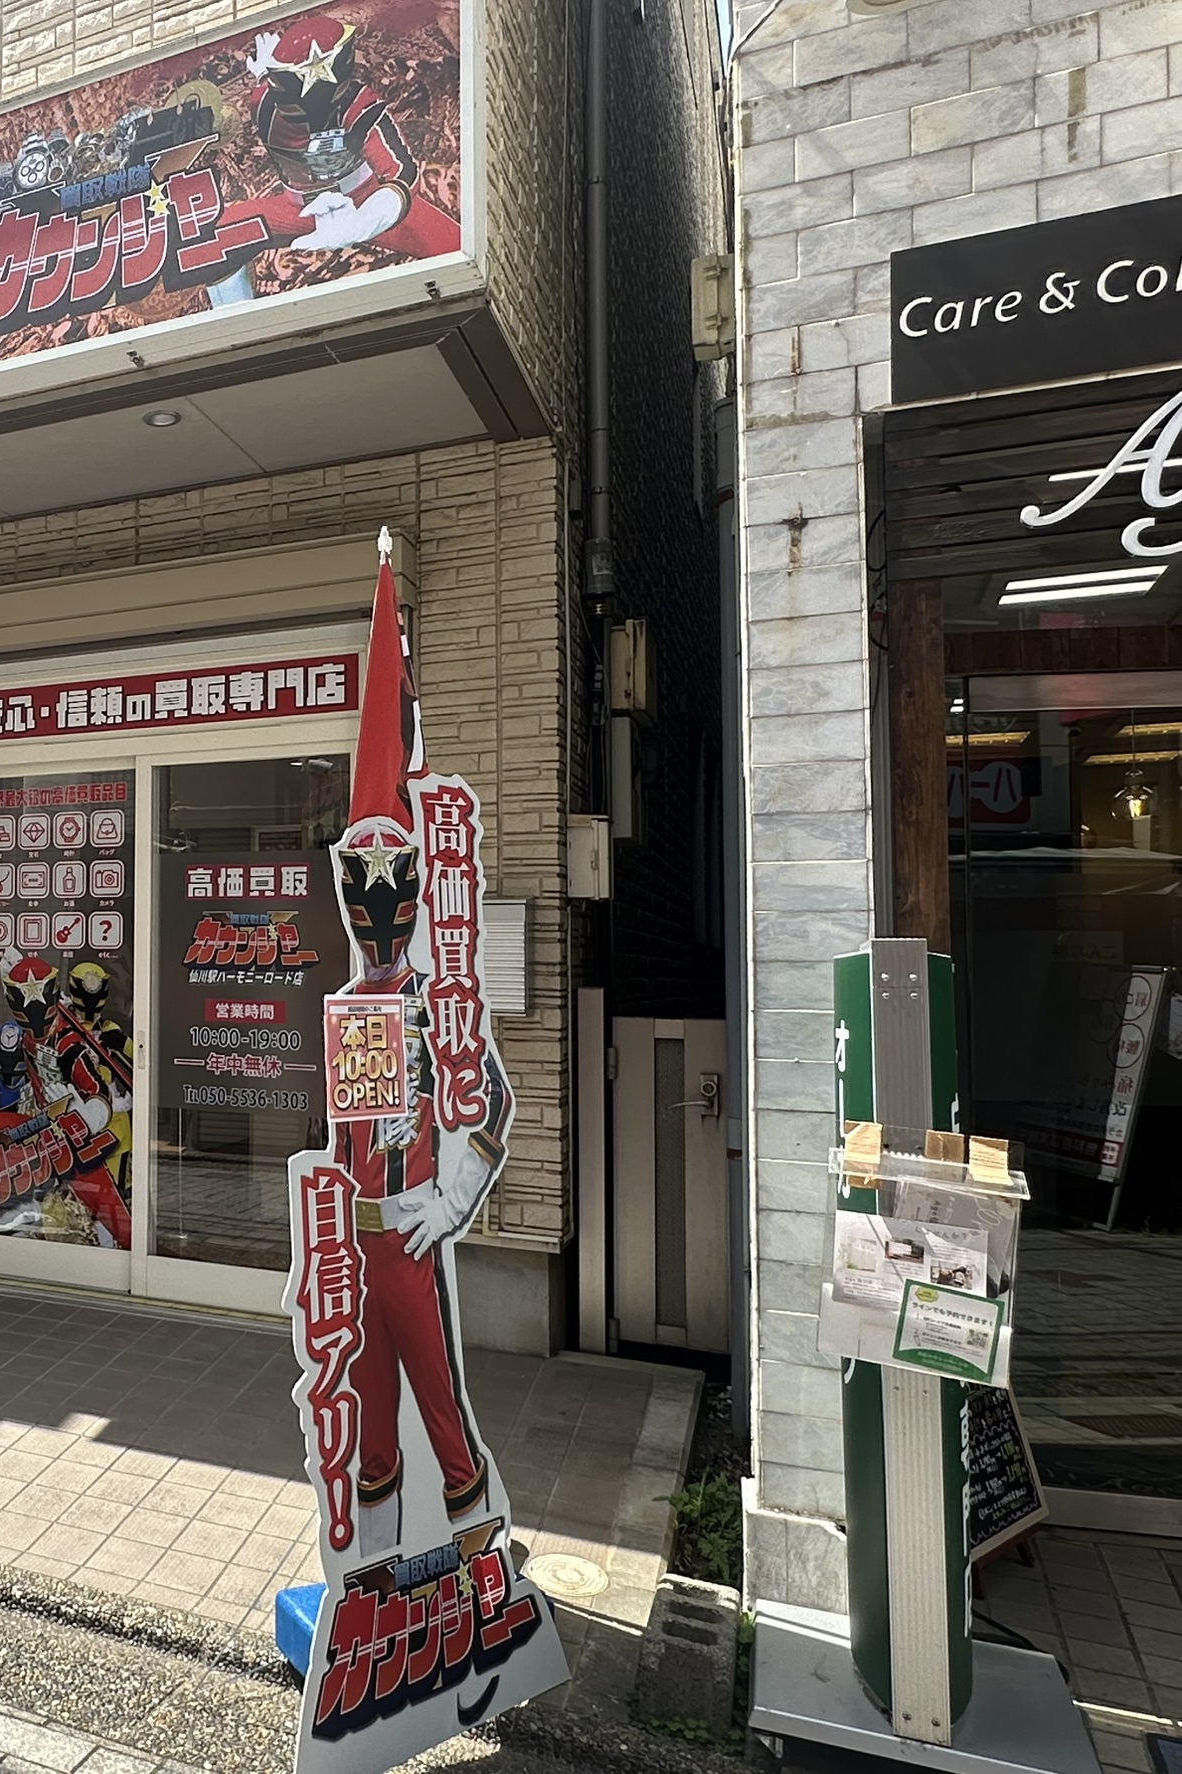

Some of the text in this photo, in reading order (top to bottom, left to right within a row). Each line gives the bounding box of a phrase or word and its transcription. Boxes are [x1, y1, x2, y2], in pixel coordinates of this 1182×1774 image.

[899, 295, 1023, 338] Care
[1039, 272, 1081, 314] &
[187, 866, 308, 898] 高価買取
[184, 917, 320, 965] カウンジャー
[426, 793, 480, 1125] 高価買取に
[216, 1003, 275, 1020] 営業時間
[189, 1026, 302, 1051] 10:00-19:00
[340, 1014, 389, 1051] 本日
[206, 1051, 282, 1079] 年中無休
[331, 1049, 399, 1082] 10:00
[333, 1080, 401, 1109] OPEN!
[303, 1175, 354, 1540] 自信アリ!
[316, 1551, 536, 1726] カウンジャー
